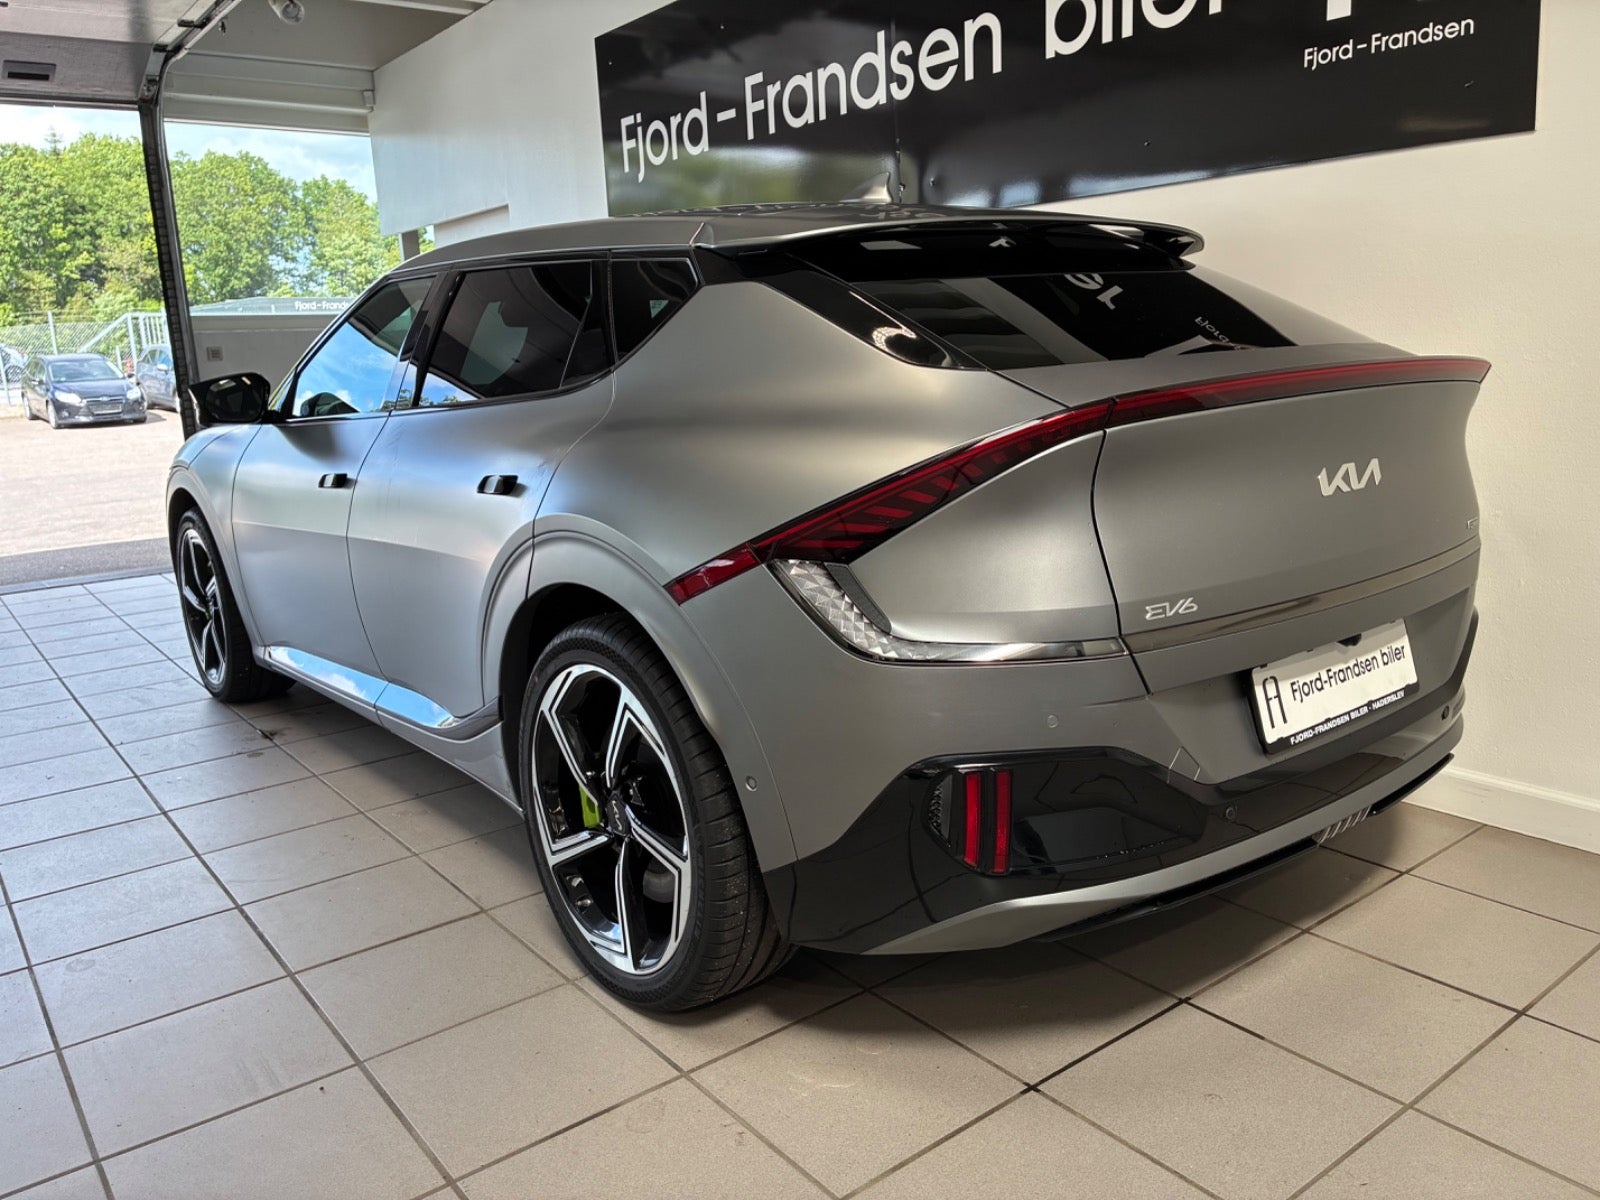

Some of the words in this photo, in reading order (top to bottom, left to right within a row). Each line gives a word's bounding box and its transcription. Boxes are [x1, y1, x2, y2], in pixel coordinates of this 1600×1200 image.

[1318, 458, 1382, 497] KIA
[1145, 597, 1198, 621] EV6
[1290, 656, 1380, 703] Fjord-Frandsen
[1380, 645, 1406, 667] biler
[1290, 713, 1350, 745] FJORD-FRANDSEN
[1350, 705, 1369, 720] BILER
[1372, 689, 1405, 711] HADERSLEV
